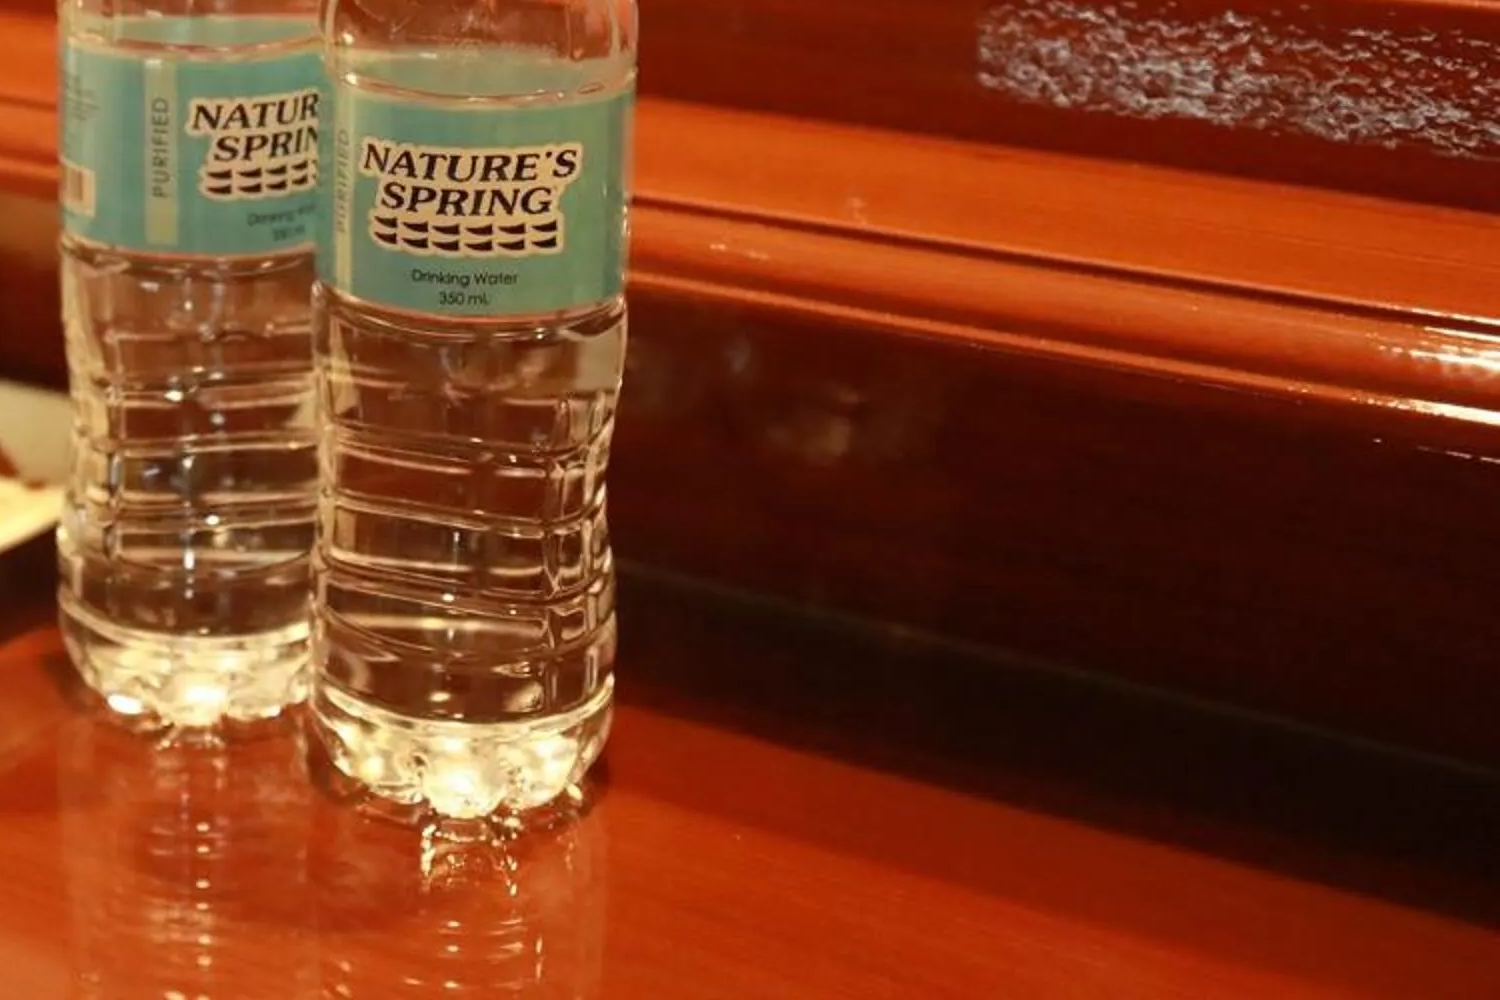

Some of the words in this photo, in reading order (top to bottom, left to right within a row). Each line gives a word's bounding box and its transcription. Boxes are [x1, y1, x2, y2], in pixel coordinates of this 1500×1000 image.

[152, 96, 170, 199] PURIFIED
[363, 143, 578, 183] NATURE'S
[380, 181, 554, 217] SPRING
[411, 268, 471, 288] Drinking
[473, 271, 519, 286] Water
[438, 291, 465, 306] 350
